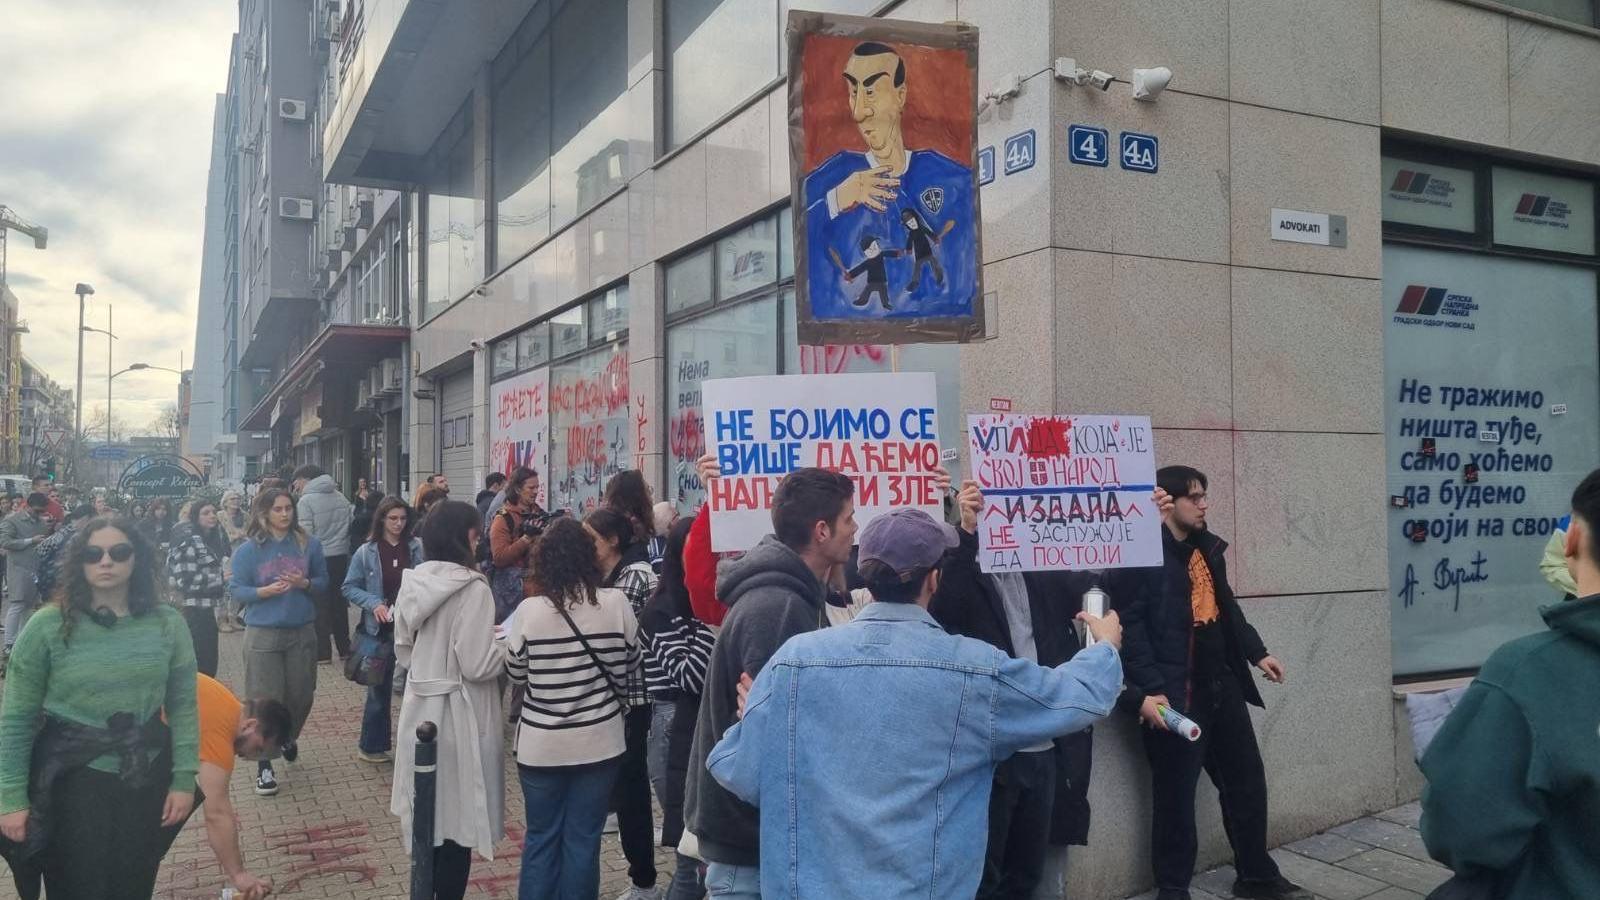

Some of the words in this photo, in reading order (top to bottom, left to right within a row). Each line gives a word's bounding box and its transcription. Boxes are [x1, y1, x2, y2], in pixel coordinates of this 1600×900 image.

[1080, 134, 1098, 159] 4
[1124, 140, 1154, 166] 4A
[1279, 220, 1321, 234] ADVOKATI
[678, 359, 710, 384] Нема
[678, 390, 702, 410] вел
[1399, 379, 1432, 404] Не
[1440, 383, 1545, 411] тражимо
[715, 409, 754, 442] НЕ
[769, 407, 890, 441] БОЈИМО
[900, 407, 936, 440] СЕ
[1400, 416, 1478, 440] ништа
[1485, 415, 1543, 445] туђе,
[1074, 425, 1120, 455] КОЈА
[1127, 426, 1148, 454] ЈЕ
[718, 441, 802, 476] ВИШЕ
[1400, 451, 1460, 472] само
[1468, 447, 1553, 472] хоћемо
[1052, 457, 1121, 491] НАРОД
[888, 475, 940, 506] ЗЛЕ
[1402, 486, 1431, 509] да
[1439, 479, 1526, 510] будемо
[1005, 492, 1124, 526] ИЗДАЛА
[989, 525, 1016, 546] НЕ
[1029, 522, 1135, 544] ЗАСЛУЖУЈЕ
[1476, 517, 1505, 537] на
[990, 550, 1023, 570] ДА
[1033, 545, 1122, 567] ПОСТОЈИ
